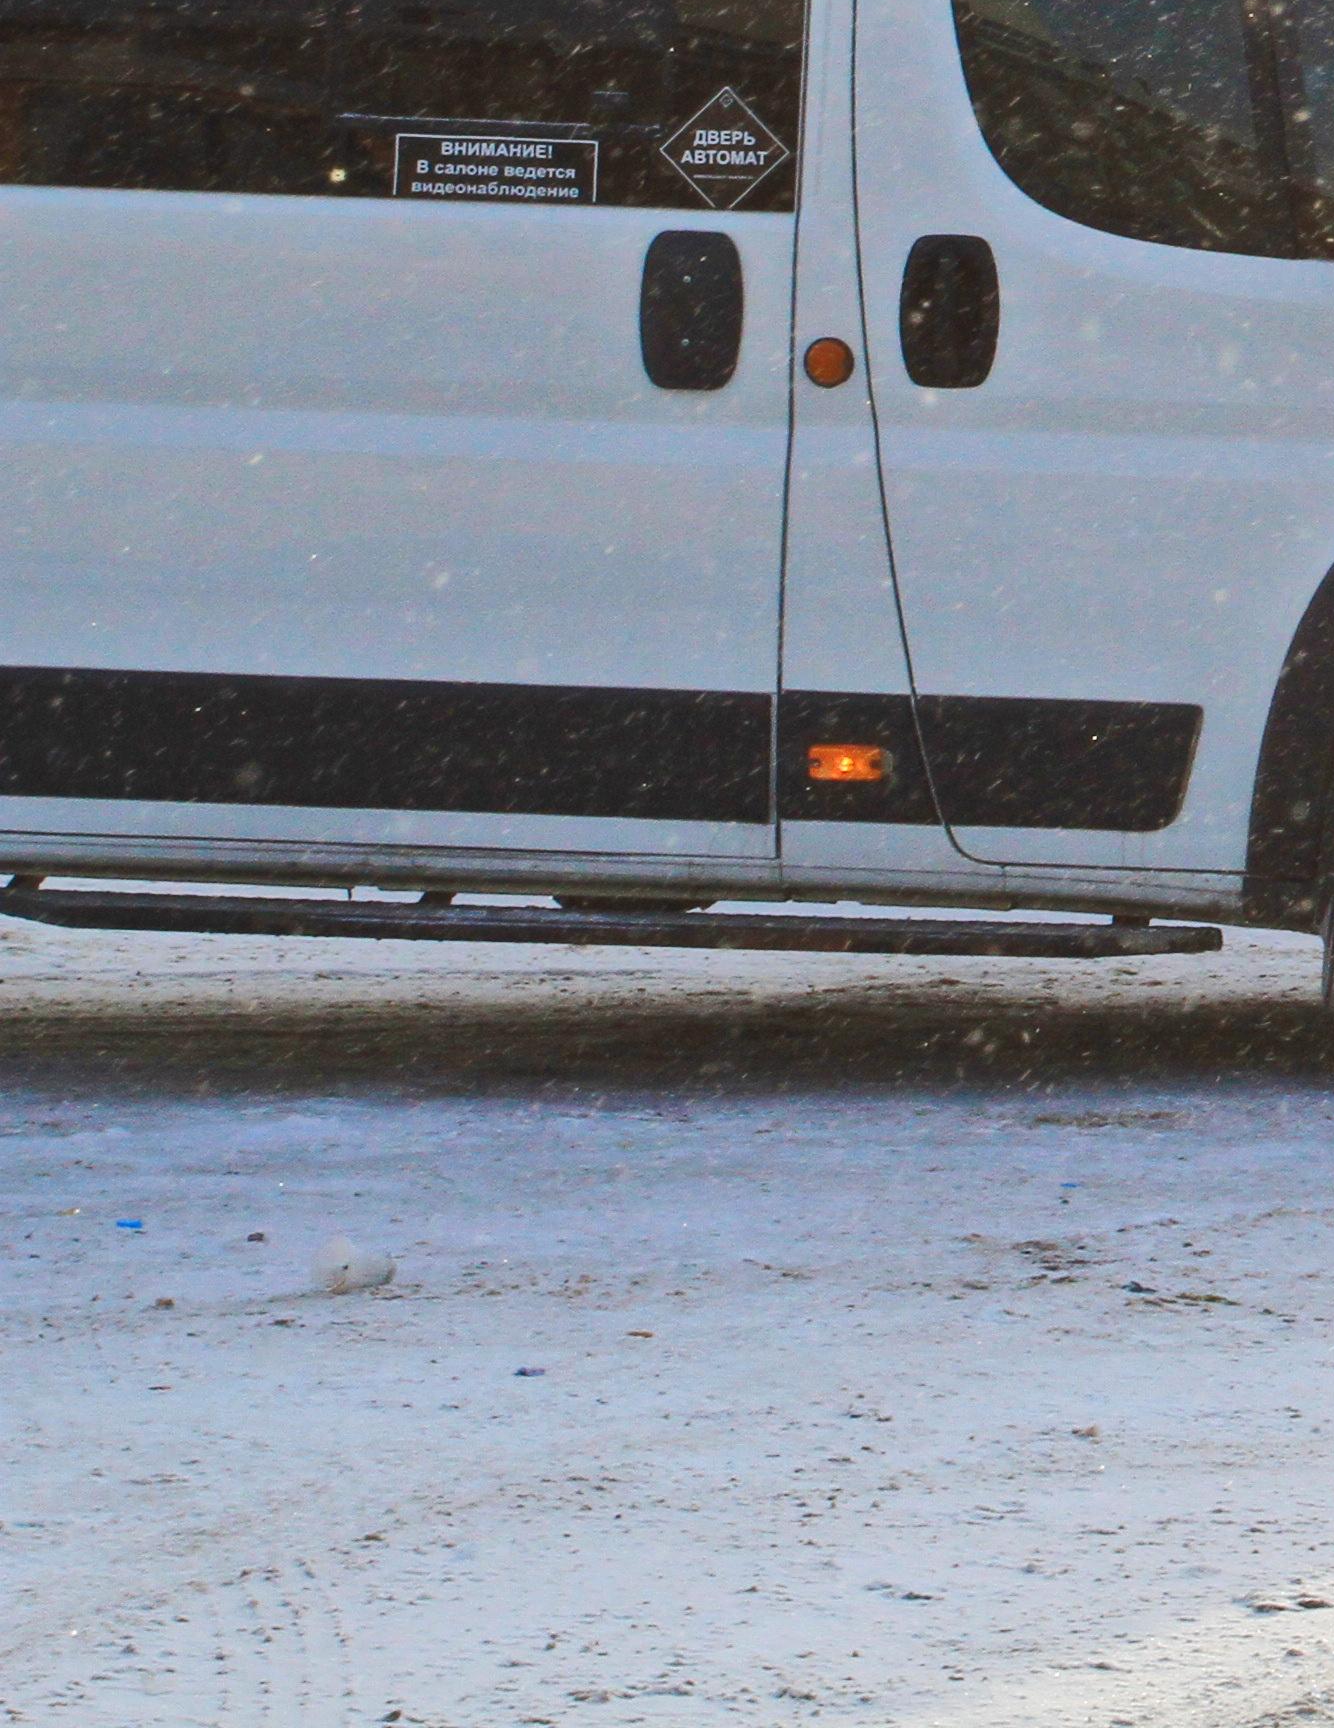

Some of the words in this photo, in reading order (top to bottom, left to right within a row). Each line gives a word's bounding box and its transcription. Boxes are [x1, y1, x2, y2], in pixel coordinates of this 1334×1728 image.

[693, 130, 756, 149] ДВЕРЬ
[441, 141, 553, 159] ВНИМАНИЕ!
[680, 149, 768, 167] АВТОМАТ
[416, 160, 429, 174] В
[434, 163, 499, 177] салоне
[504, 165, 576, 180] ведется
[411, 180, 579, 199] видеонаблюдение
